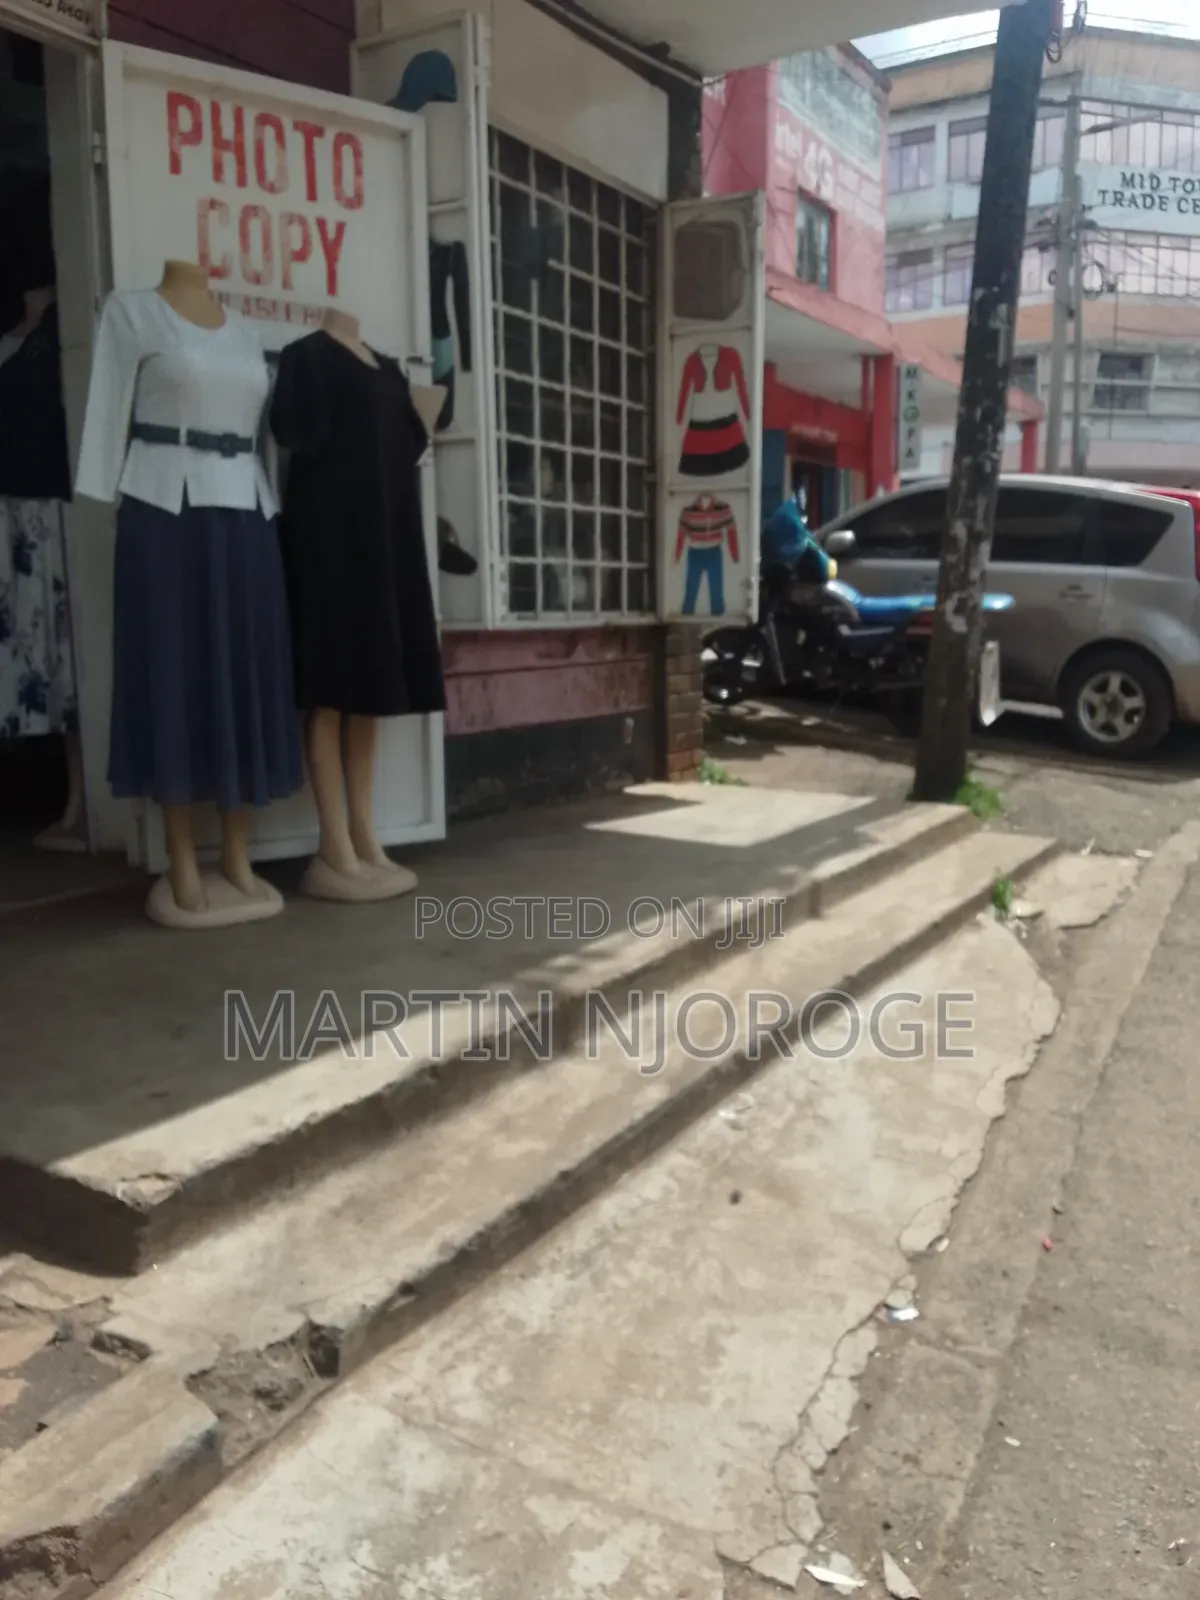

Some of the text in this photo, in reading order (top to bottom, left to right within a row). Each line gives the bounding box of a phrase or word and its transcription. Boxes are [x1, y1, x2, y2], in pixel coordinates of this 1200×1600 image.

[166, 90, 365, 211] PHOTO
[1098, 189, 1169, 212] TRADE
[1120, 171, 1200, 195] MID TO
[196, 197, 347, 297] COPY
